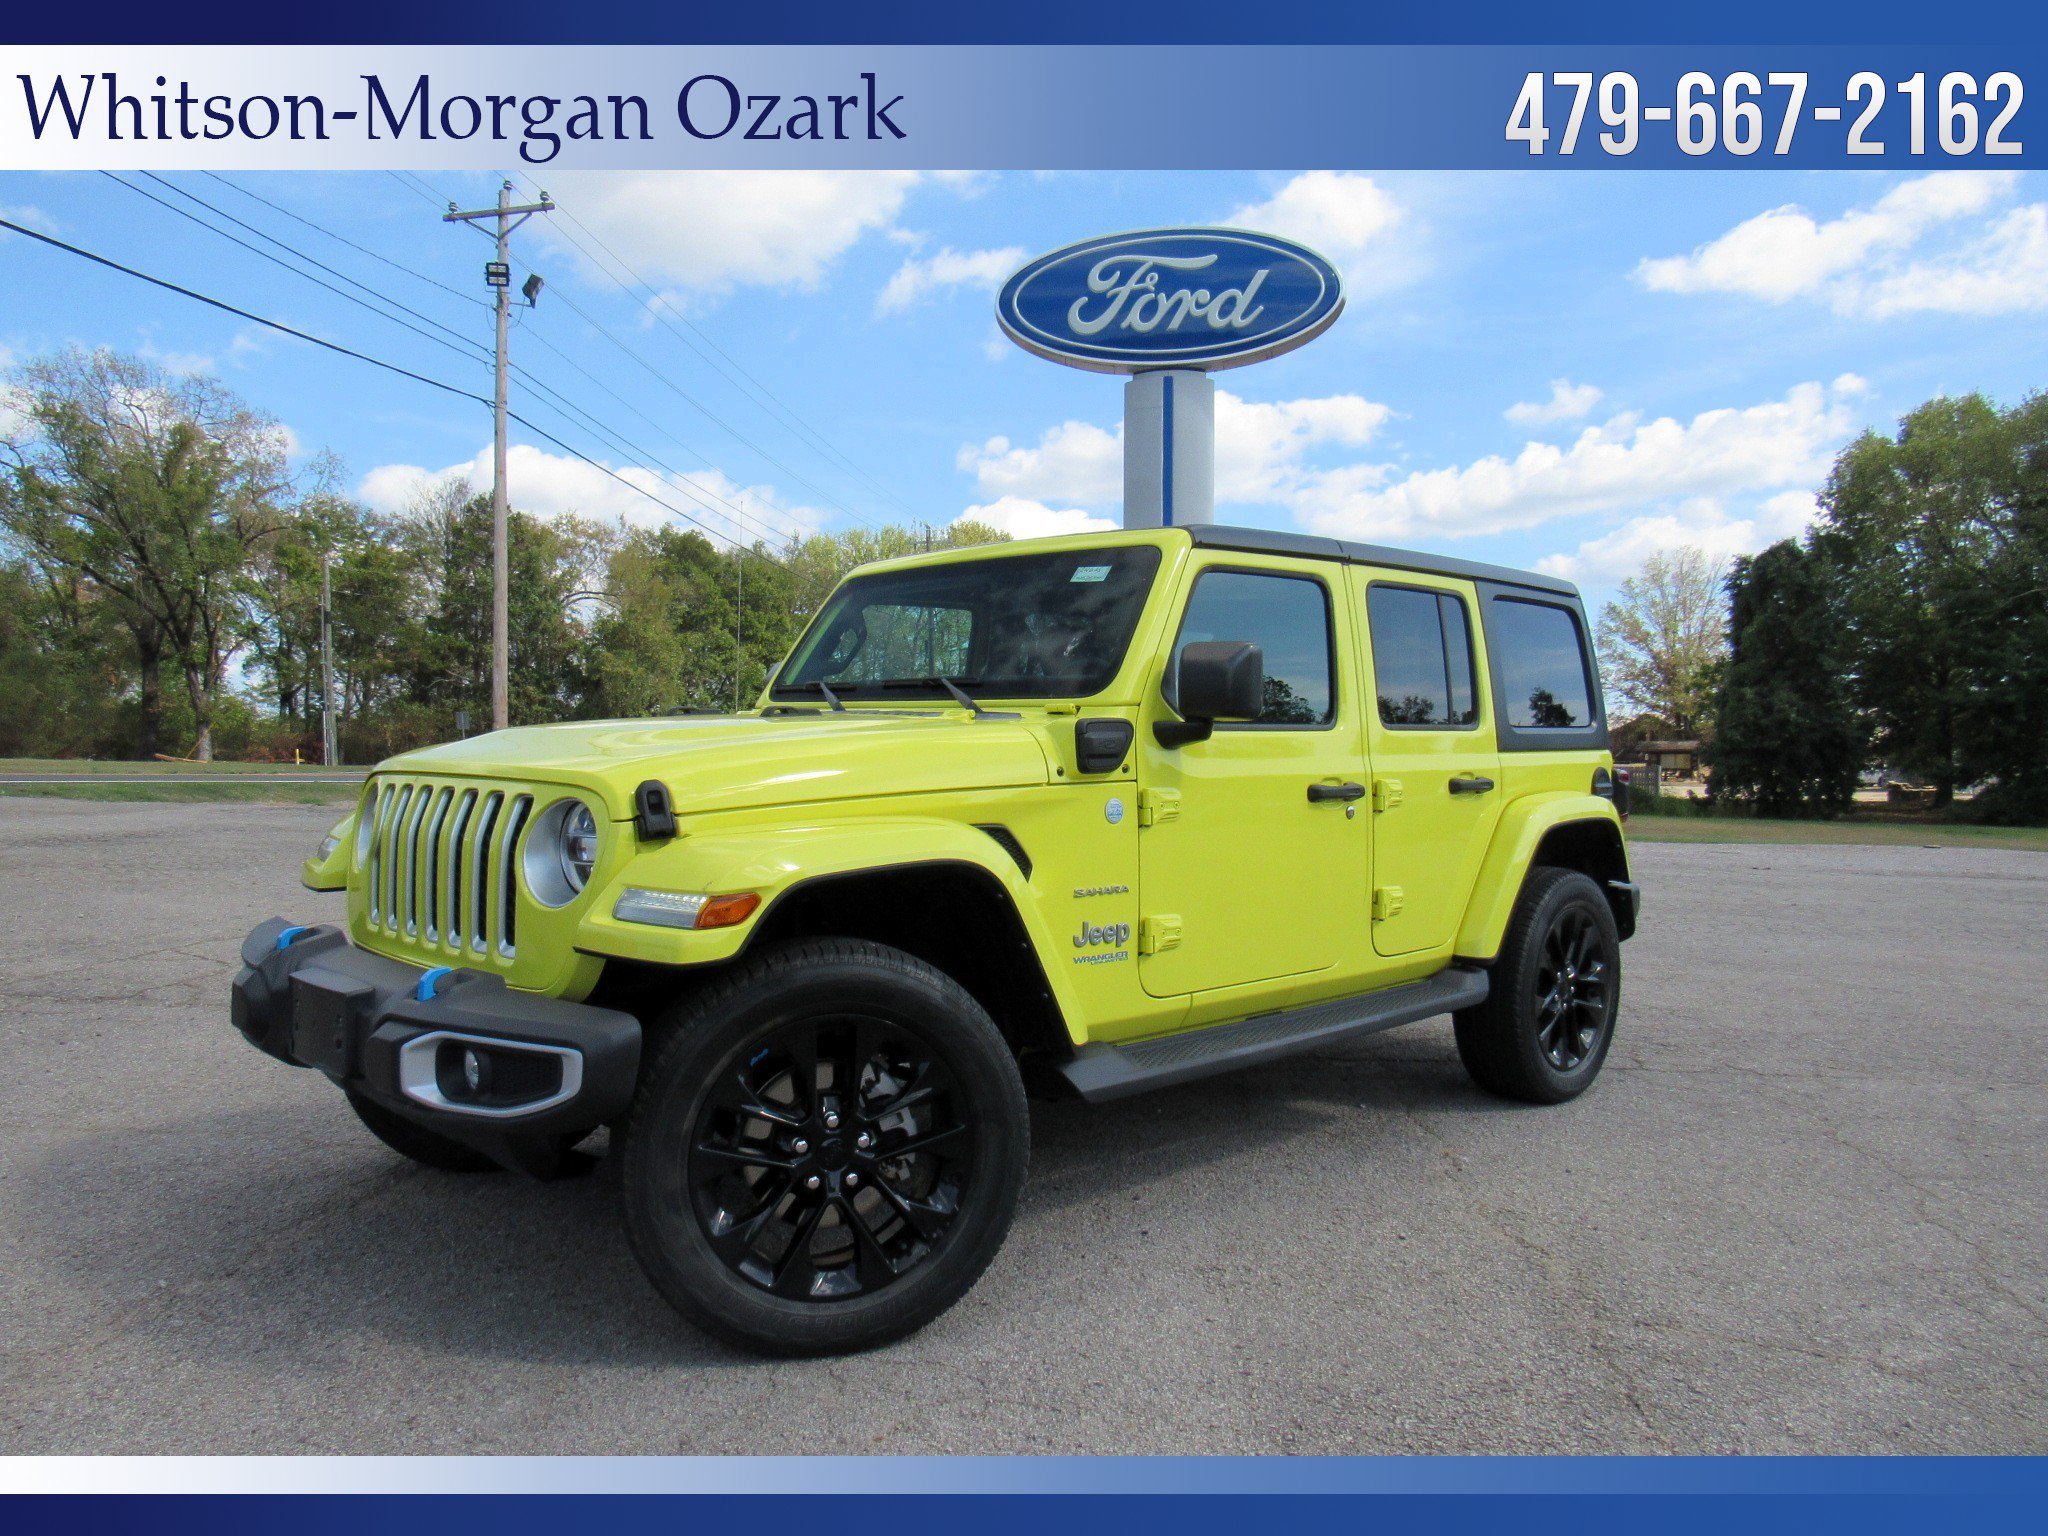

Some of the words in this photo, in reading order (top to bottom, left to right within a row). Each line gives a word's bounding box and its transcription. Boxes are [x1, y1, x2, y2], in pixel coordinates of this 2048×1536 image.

[1067, 254, 1269, 335] Ford
[1073, 885, 1129, 898] SAHARA
[1073, 921, 1130, 948] Jeep
[1073, 951, 1128, 964] WRANGLER
